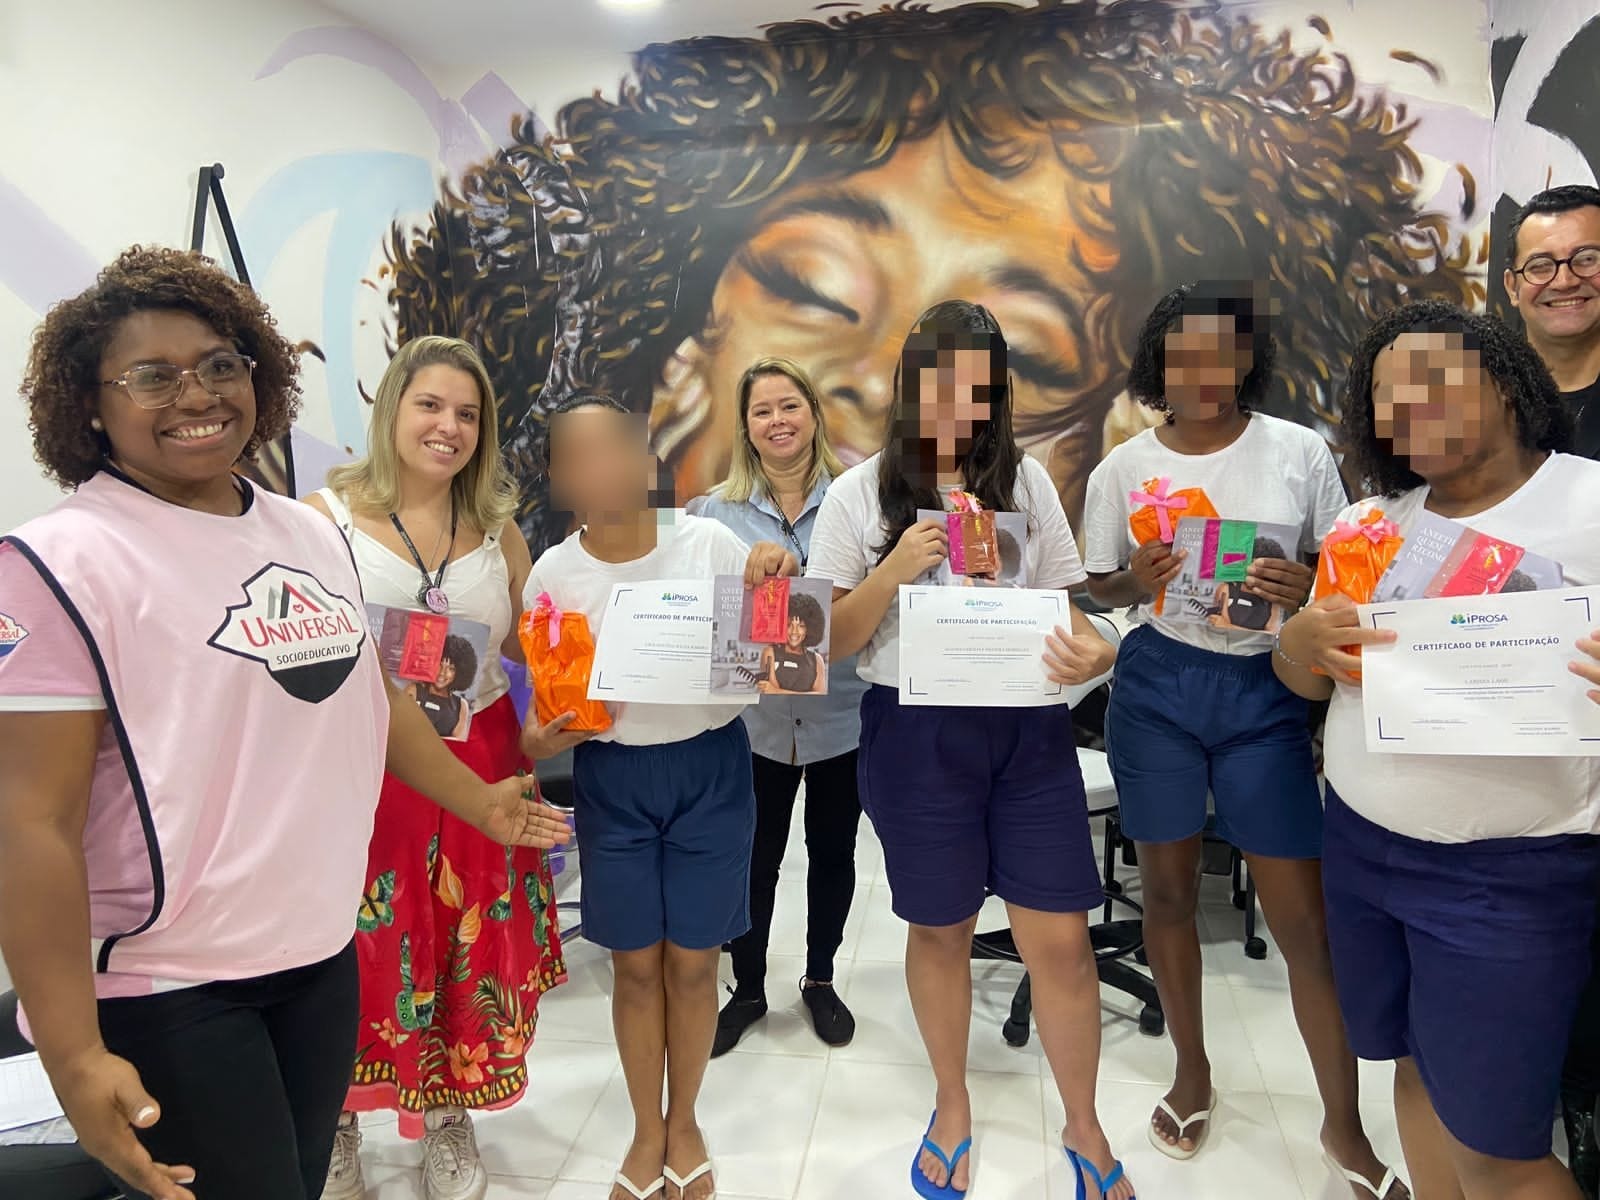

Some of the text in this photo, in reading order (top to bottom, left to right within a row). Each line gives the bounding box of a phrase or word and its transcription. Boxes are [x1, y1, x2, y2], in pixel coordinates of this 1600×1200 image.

[632, 613, 672, 621] CERTIFICADO
[990, 618, 1038, 627] PARTICIPAÇÃO
[1466, 613, 1509, 624] iPROSA
[240, 607, 359, 648] UNIVERSAL
[1412, 636, 1560, 652] CERTIFICADO DE PARTICIPAÇÃO
[276, 643, 351, 665] SOCIOEDUCATIVO
